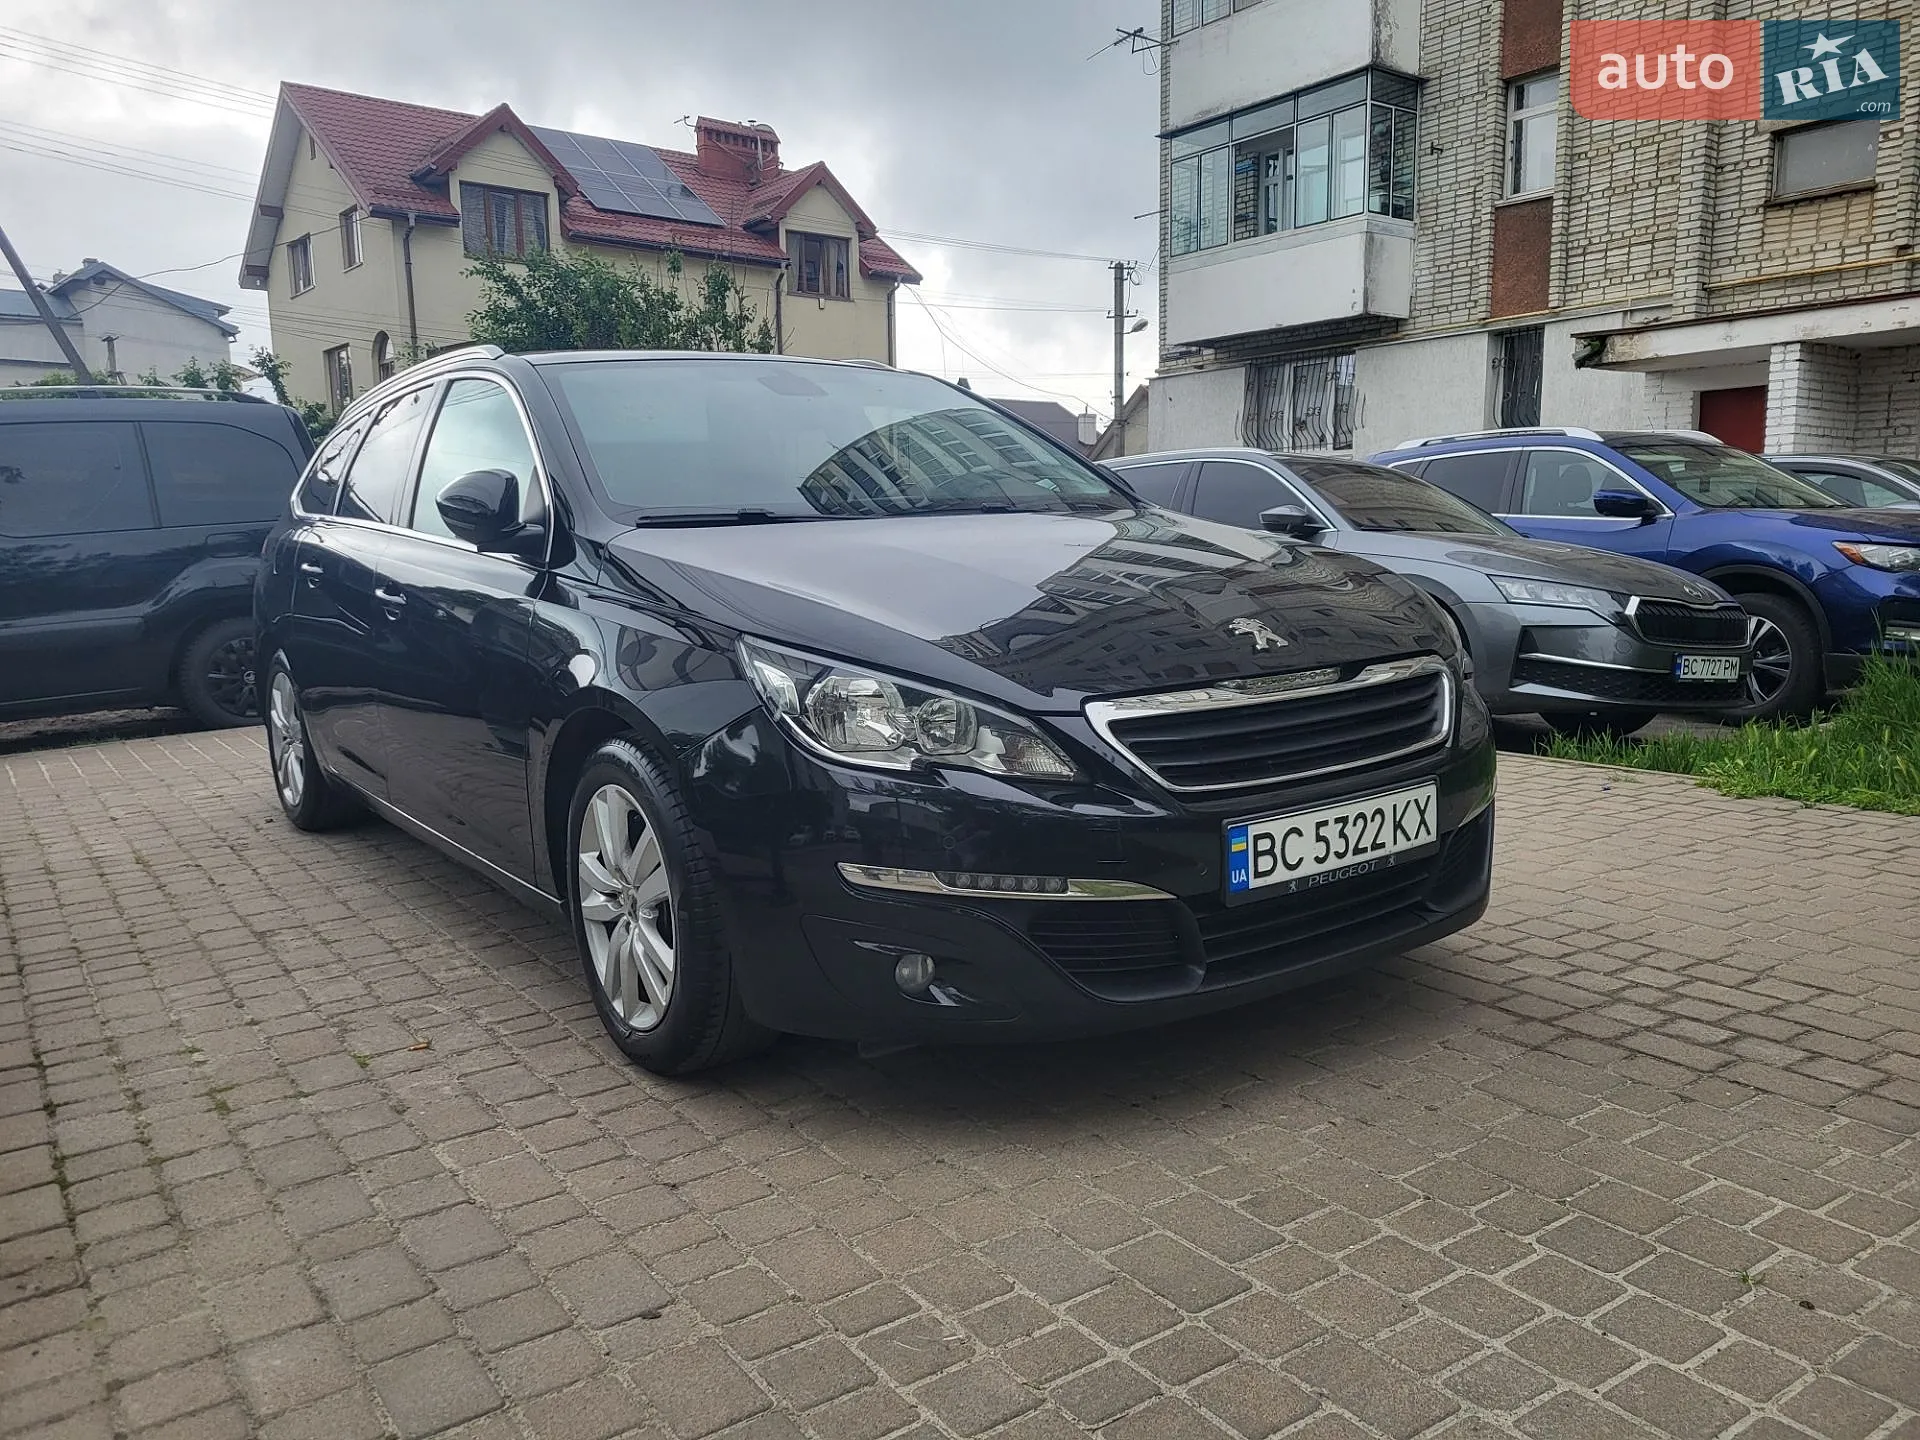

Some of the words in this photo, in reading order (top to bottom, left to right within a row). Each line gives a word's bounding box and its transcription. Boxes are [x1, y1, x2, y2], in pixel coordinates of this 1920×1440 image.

[1683, 658, 1697, 675] BC
[1700, 659, 1721, 676] 7727
[1723, 660, 1738, 676] PM
[1253, 826, 1304, 879] BC
[1314, 808, 1386, 864] 5322
[1392, 794, 1432, 846] KX
[1231, 869, 1248, 884] UA
[1308, 859, 1379, 888] PEUGEOT
